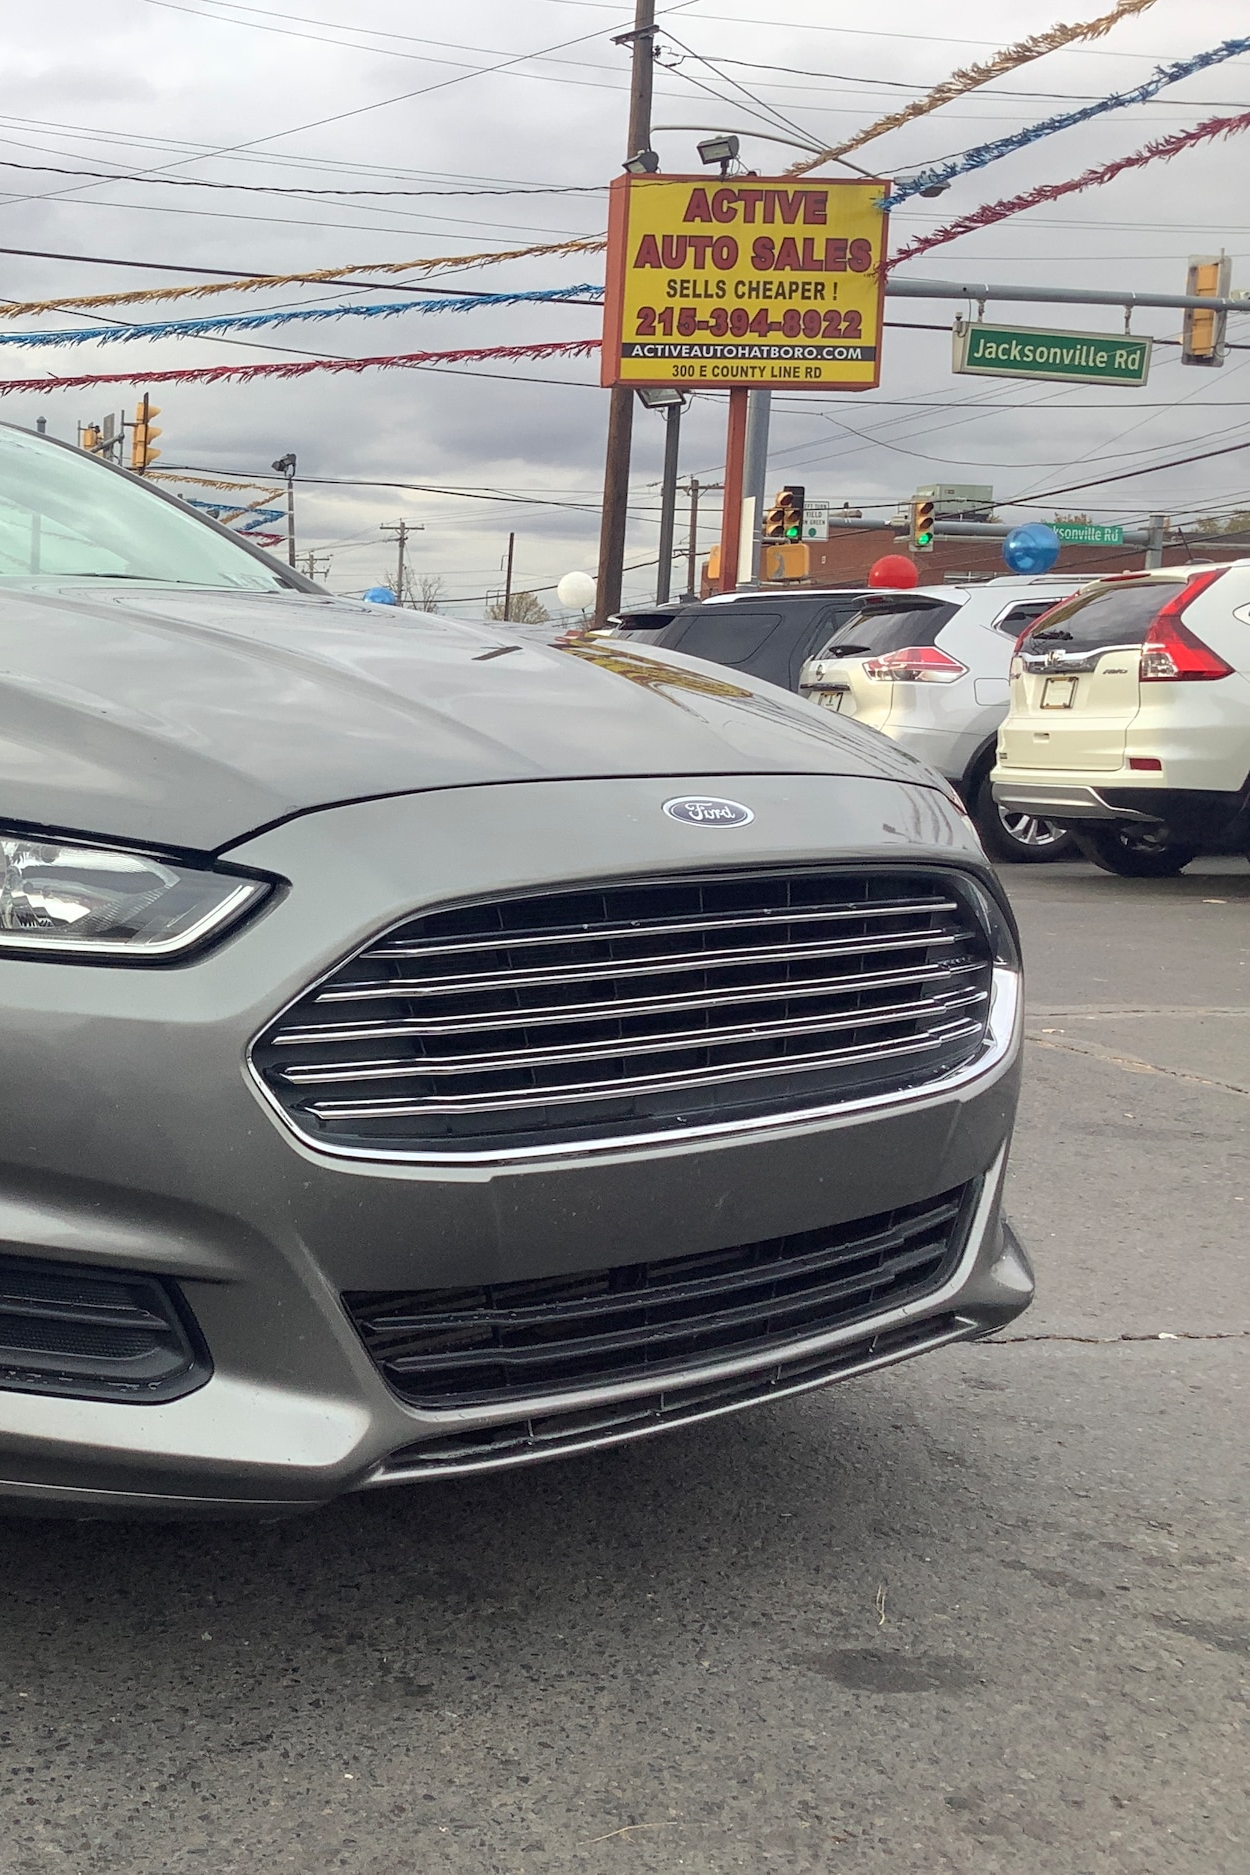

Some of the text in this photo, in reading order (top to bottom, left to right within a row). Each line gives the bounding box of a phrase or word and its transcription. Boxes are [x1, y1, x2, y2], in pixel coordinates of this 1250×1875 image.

[683, 188, 828, 225] ACTIVE
[633, 235, 872, 272] AUTO SALES
[666, 279, 726, 299] SELLS
[734, 281, 826, 300] CHEAPER
[635, 306, 862, 339] 215-394-8922
[632, 344, 862, 360] ACTIVEAUTOHATBORO.COM
[973, 338, 1141, 371] Jacksonville Rd
[672, 365, 822, 379] 300 E COUNTY LINE RD
[1052, 525, 1119, 542] ksonville Rd
[684, 802, 736, 821] Ford
